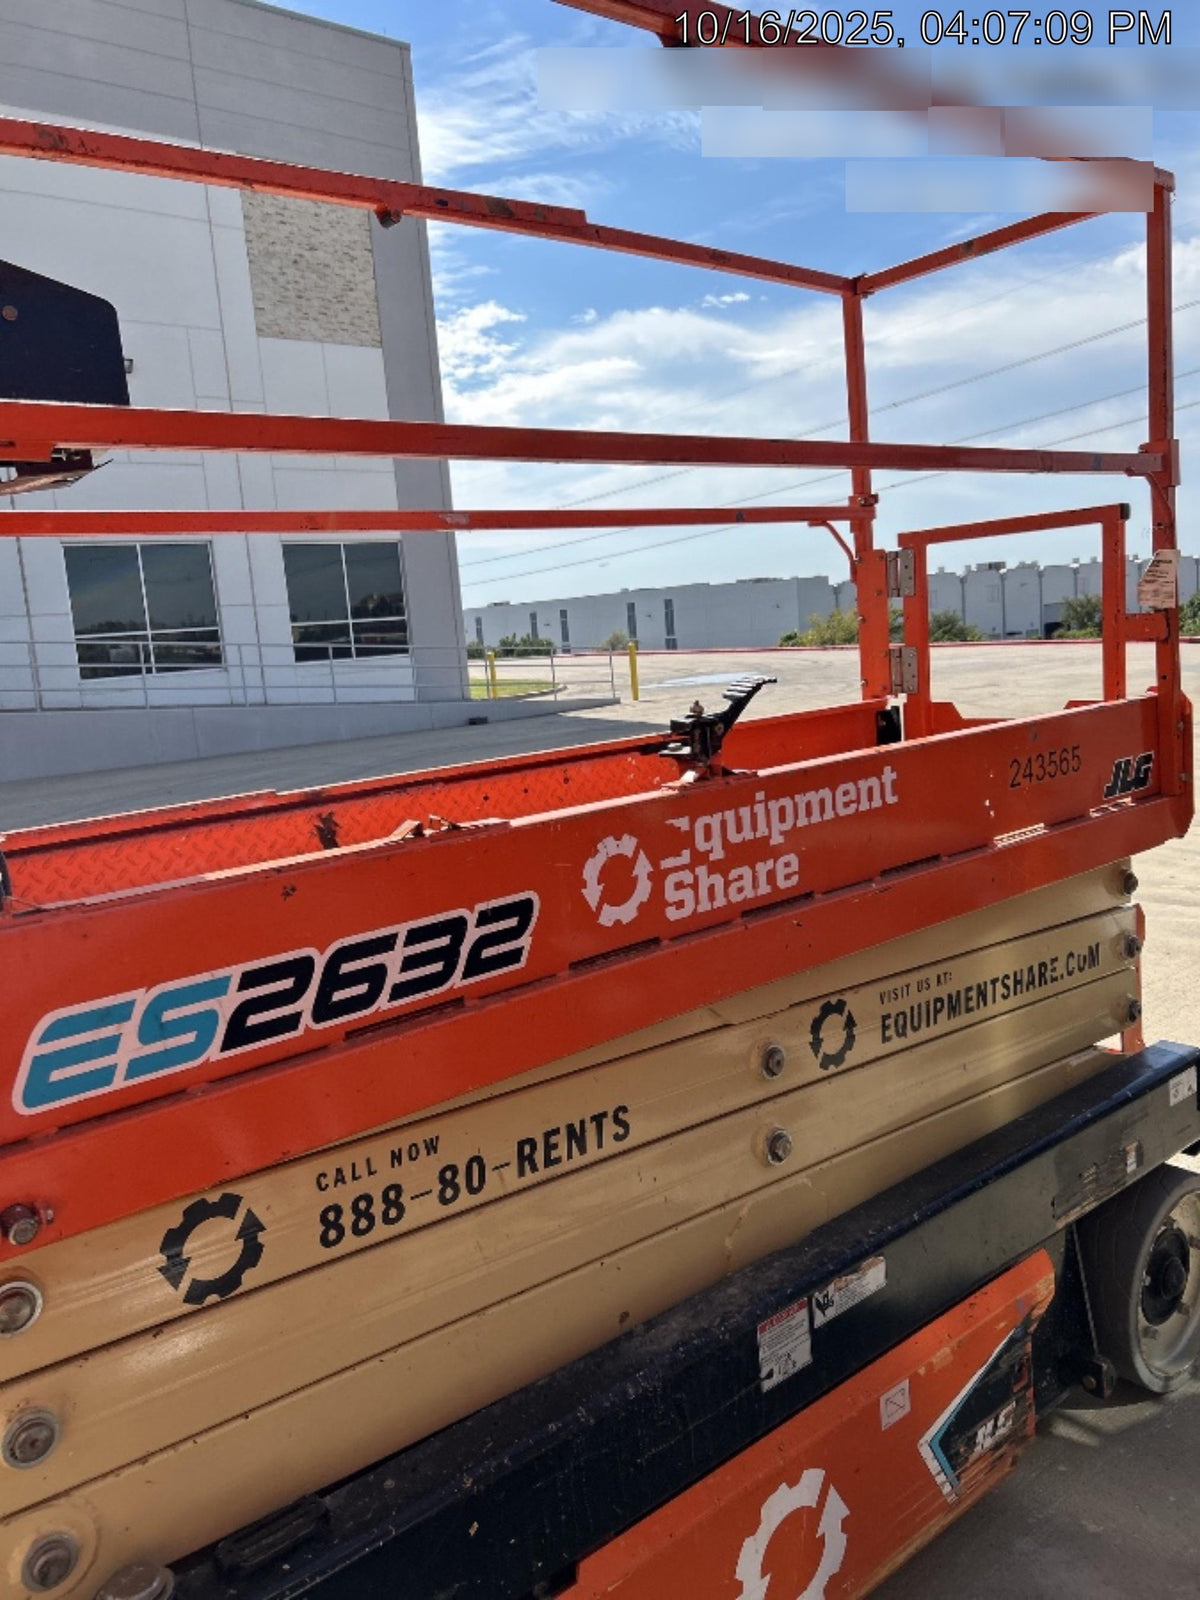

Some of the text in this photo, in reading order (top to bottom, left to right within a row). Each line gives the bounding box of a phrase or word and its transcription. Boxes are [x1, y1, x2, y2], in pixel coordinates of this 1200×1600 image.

[1010, 746, 1081, 788] 243565
[1104, 751, 1154, 799] JLG
[664, 853, 799, 921] Share
[13, 892, 541, 1115] ES2632
[879, 983, 911, 1005] VISIT
[916, 976, 931, 993] US
[316, 1135, 440, 1192] CALL NOW
[318, 1104, 631, 1249] 888-80-RENTS
